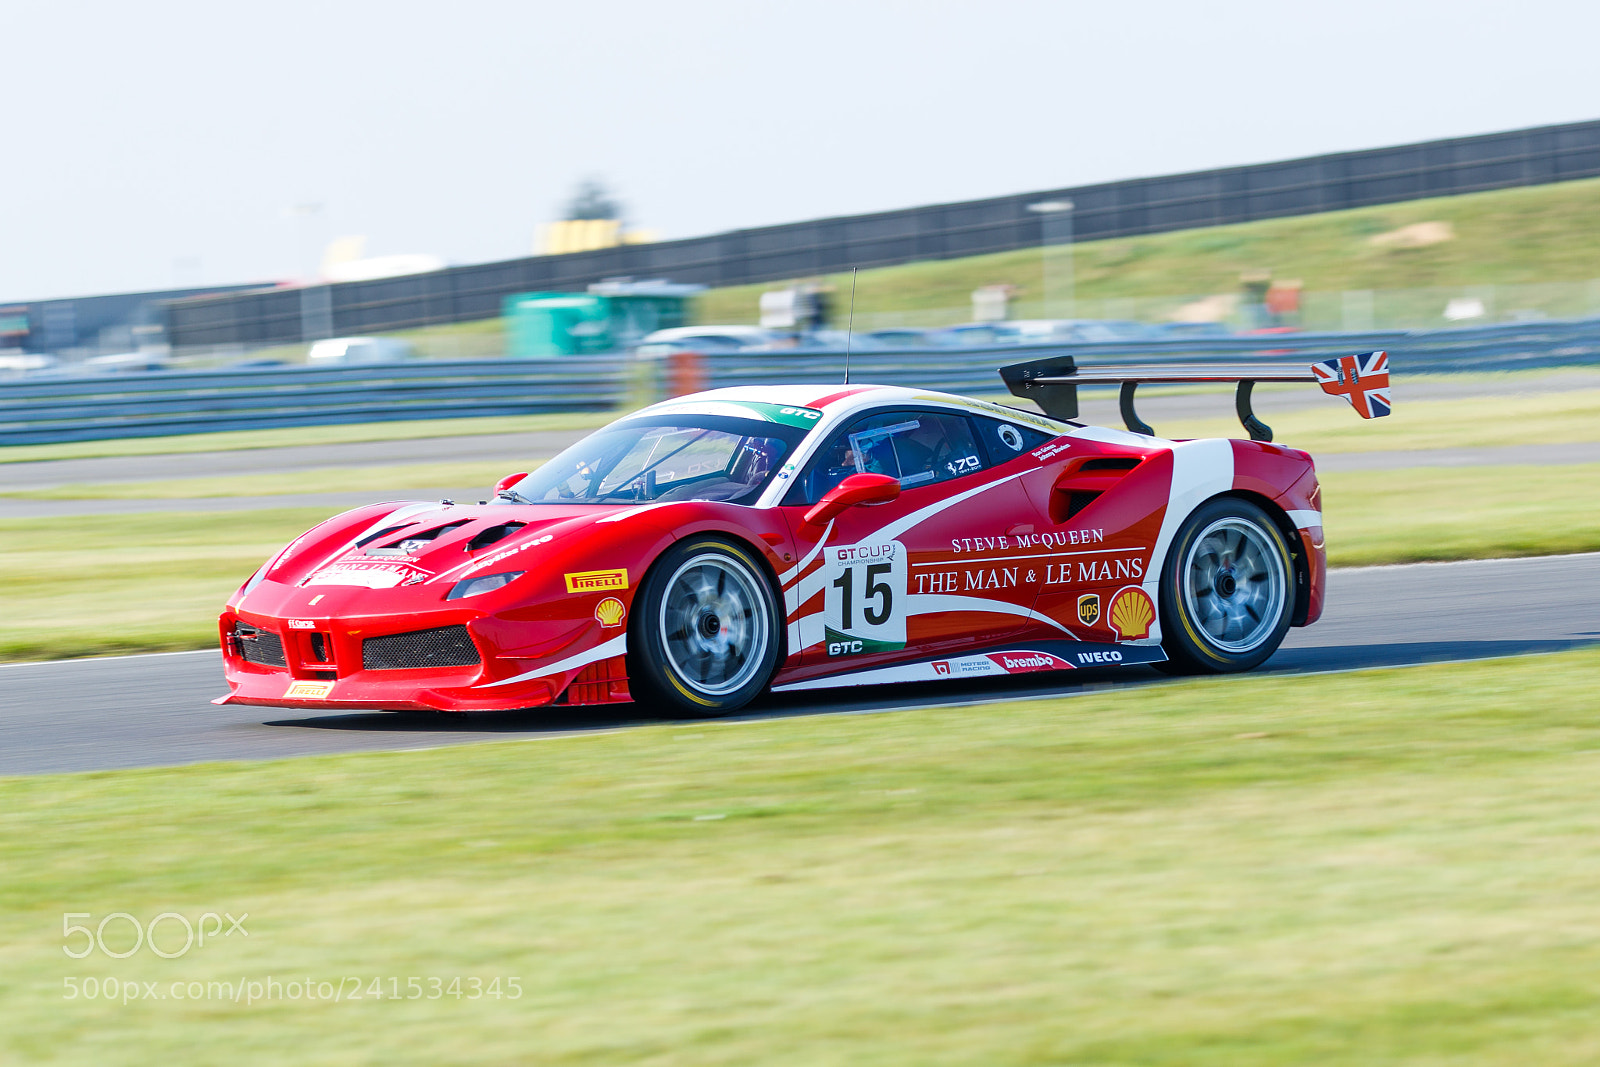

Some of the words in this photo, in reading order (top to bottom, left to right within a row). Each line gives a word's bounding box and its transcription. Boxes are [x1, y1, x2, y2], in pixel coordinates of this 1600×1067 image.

[780, 407, 820, 420] GTC
[955, 456, 980, 470] 70
[953, 536, 1009, 553] STEVE
[1017, 528, 1104, 549] McQUEEN
[838, 548, 855, 560] GT
[859, 544, 891, 558] CUP
[838, 557, 884, 567] CHAMPIONSHIP
[571, 573, 623, 589] PIRELLI
[915, 572, 959, 594] THE
[964, 567, 1019, 590] MAN
[1026, 569, 1037, 583] &
[1045, 563, 1073, 584] LE
[1078, 558, 1143, 582] MANS
[834, 563, 893, 630] 15
[1079, 602, 1098, 618] ups
[829, 639, 864, 656] GTC
[1004, 653, 1054, 669] brembo
[1077, 650, 1122, 664] IVECO
